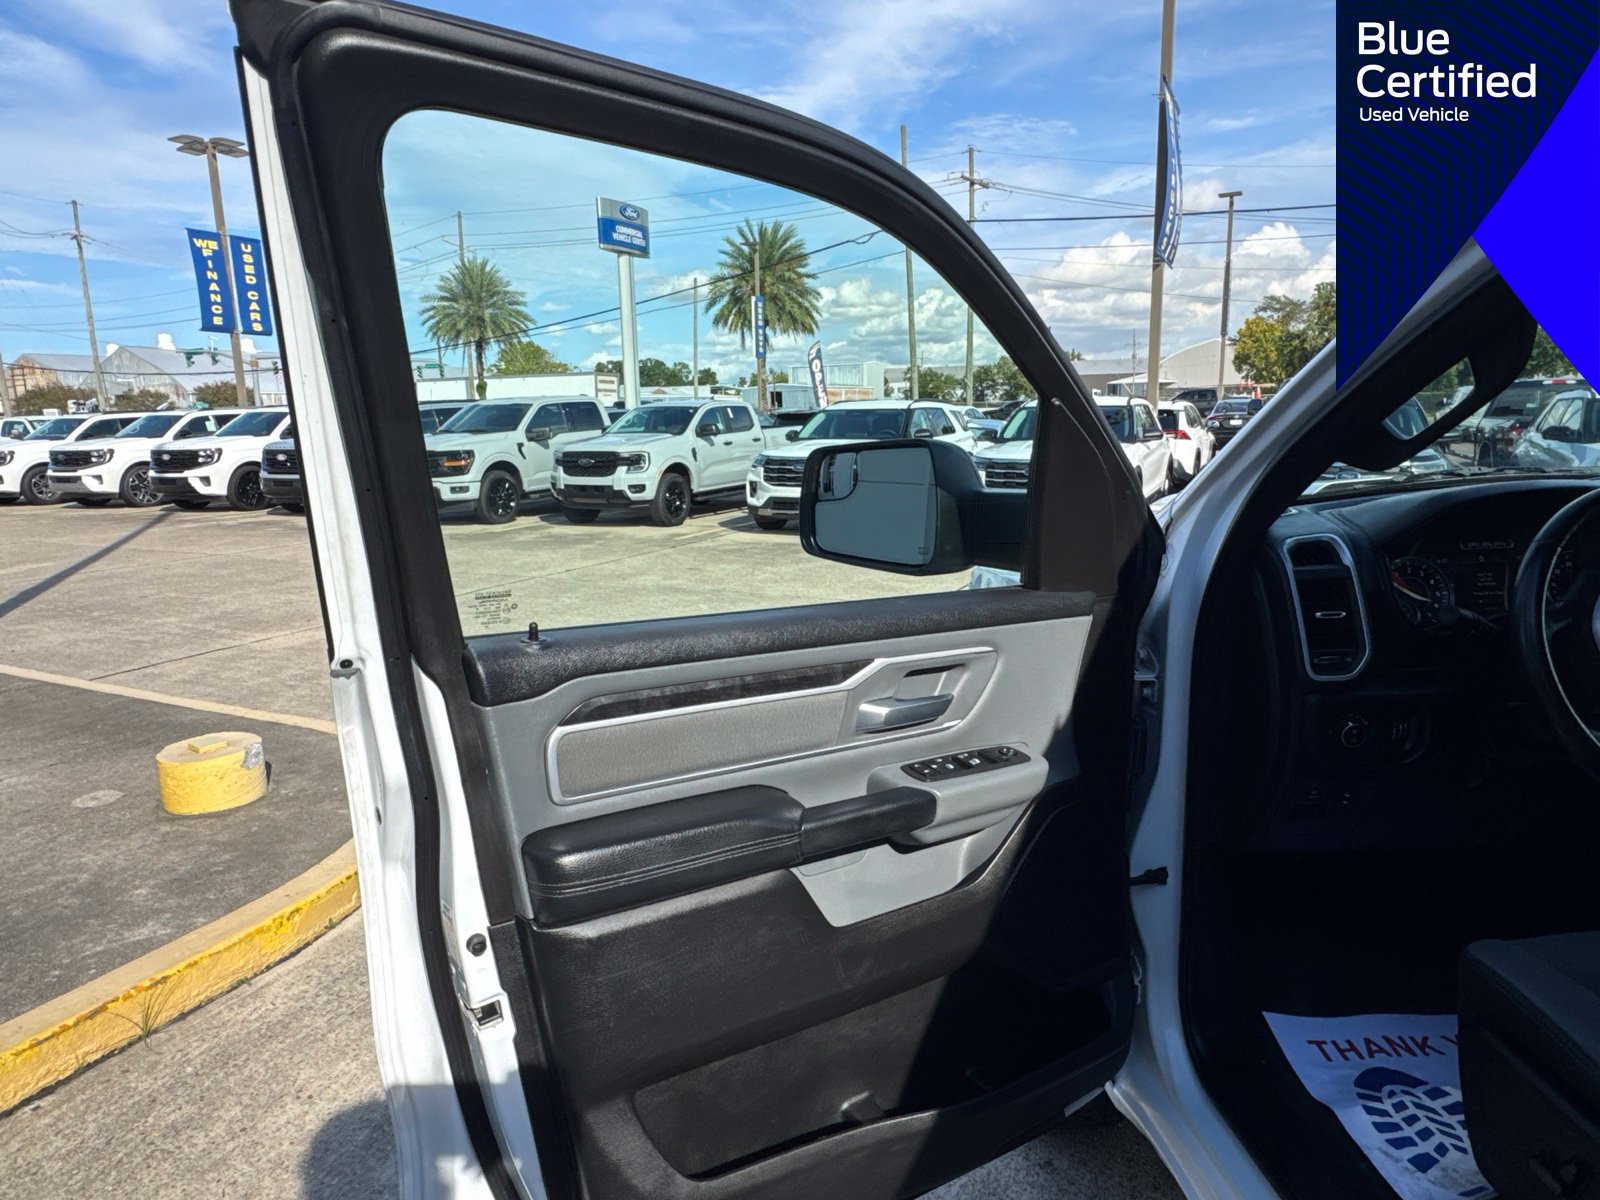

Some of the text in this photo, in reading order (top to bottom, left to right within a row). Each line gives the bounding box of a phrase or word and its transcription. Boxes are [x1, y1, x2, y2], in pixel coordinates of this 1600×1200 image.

[622, 205, 639, 219] Ford
[612, 232, 632, 243] VEHICLE
[193, 238, 223, 325] WE FINANCE
[241, 243, 263, 332] USED CARS
[1306, 1035, 1447, 1062] THANK
